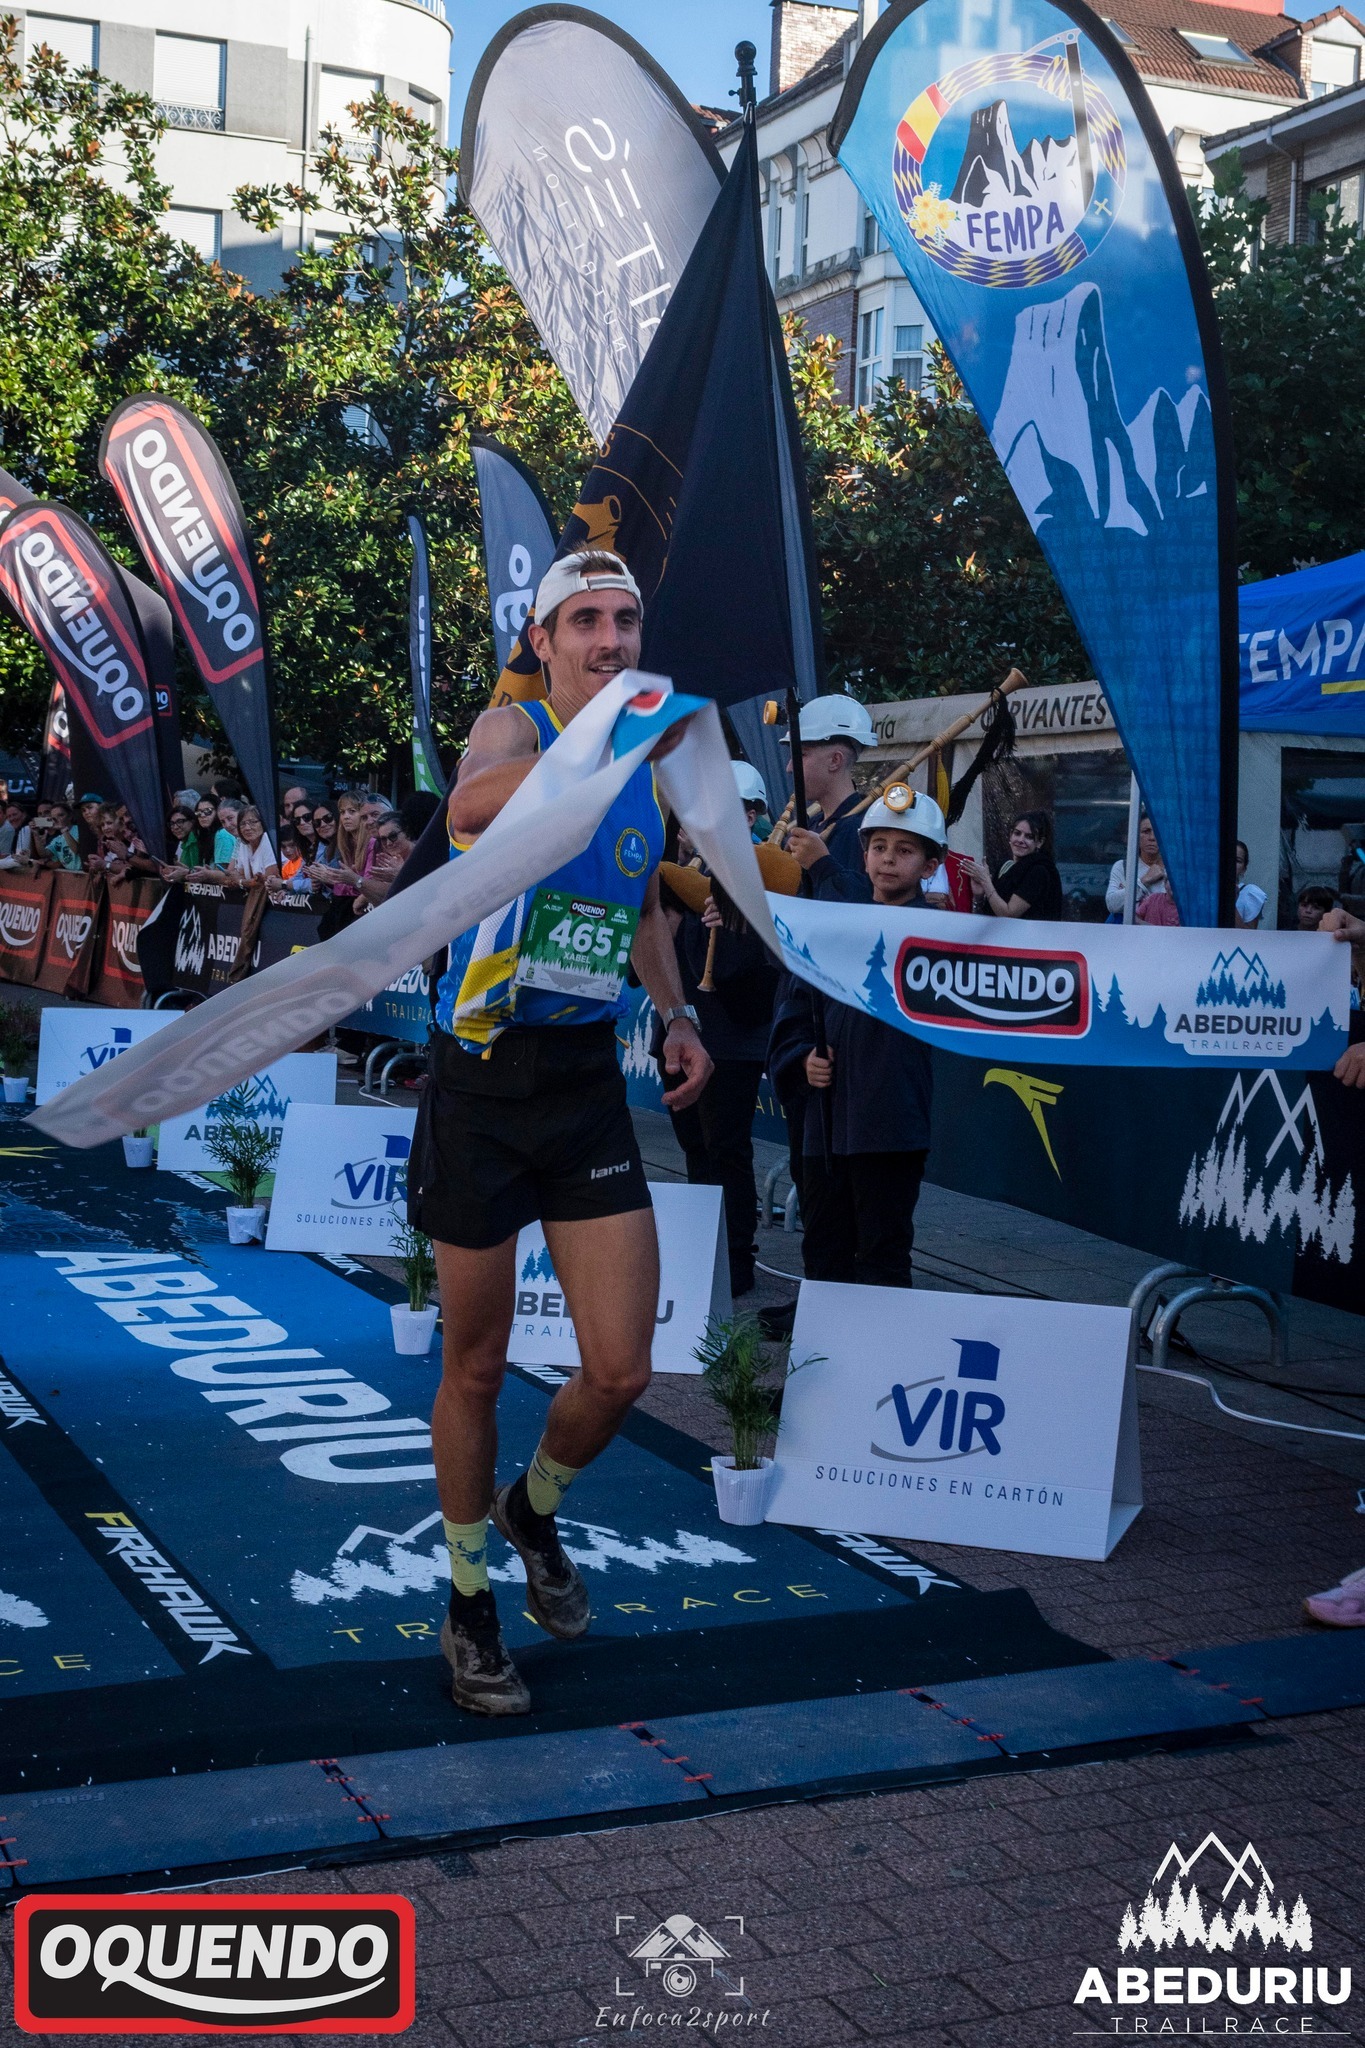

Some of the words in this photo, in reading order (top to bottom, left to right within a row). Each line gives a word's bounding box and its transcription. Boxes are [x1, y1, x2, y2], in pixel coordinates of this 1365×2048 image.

[966, 201, 1066, 254] FEMPA
[981, 693, 1106, 732] CRVANTES
[0, 902, 41, 936] QUENDO
[571, 902, 606, 918] OQUENDO
[548, 918, 615, 958] 465
[563, 951, 591, 965] XABEL
[905, 955, 1076, 1004] OQUENDO
[1173, 1012, 1303, 1037] ABEDURIU
[86, 1047, 129, 1070] VI
[1191, 1039, 1285, 1051] TRAILRACE
[590, 1160, 630, 1181] land
[296, 1213, 373, 1227] SOLUCIONES
[378, 1218, 394, 1227] EN
[35, 1250, 438, 1484] ABEDURIU
[891, 1384, 1006, 1456] VIR
[815, 1465, 938, 1492] SOLUCIONES
[949, 1480, 973, 1496] EN
[984, 1484, 1064, 1506] CARTÓN
[84, 1511, 253, 1665] FIREHAWK
